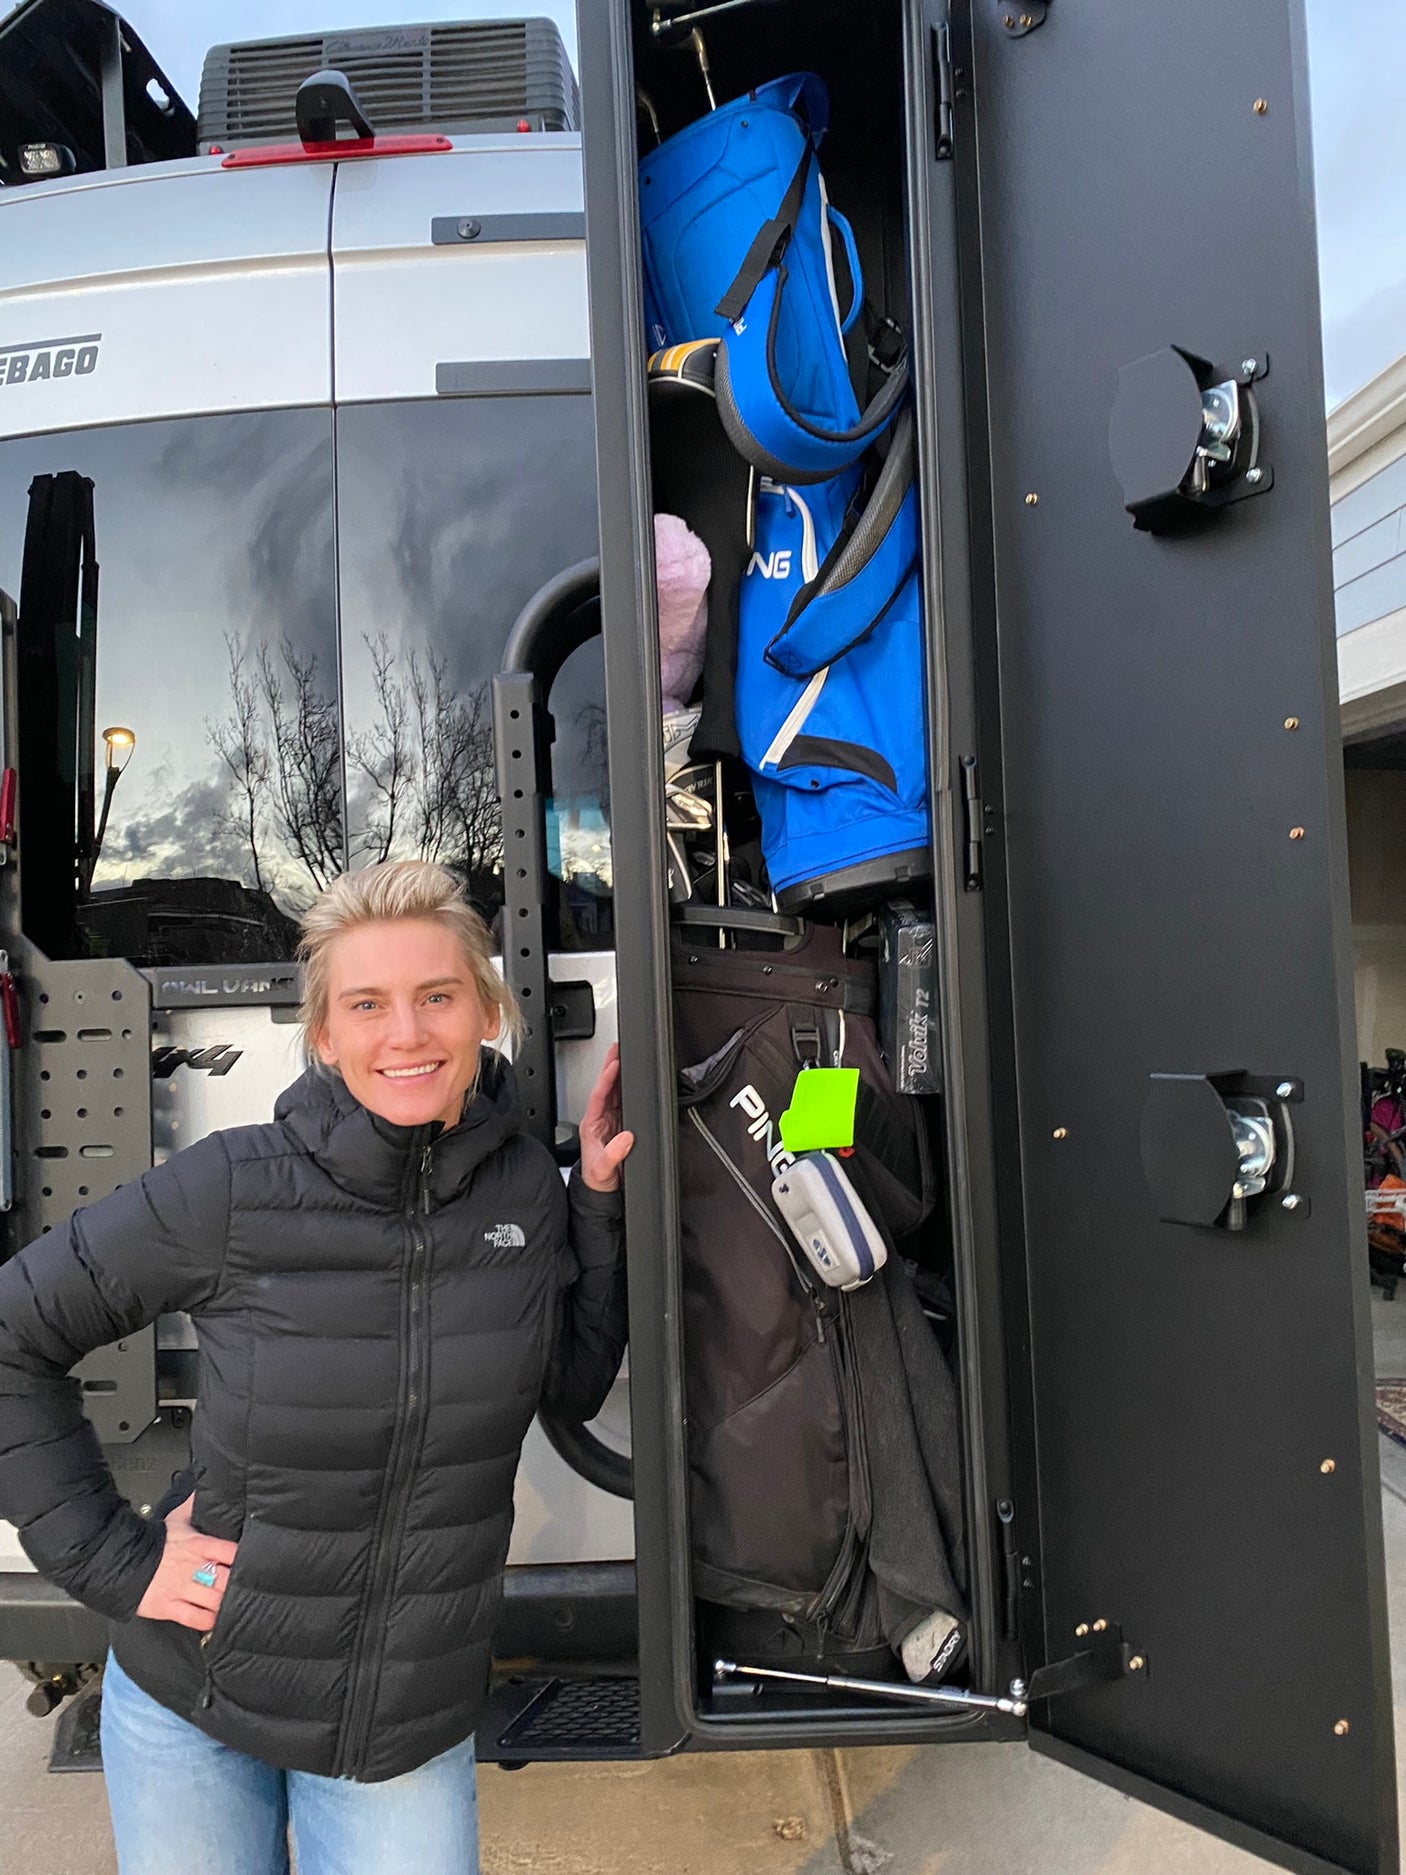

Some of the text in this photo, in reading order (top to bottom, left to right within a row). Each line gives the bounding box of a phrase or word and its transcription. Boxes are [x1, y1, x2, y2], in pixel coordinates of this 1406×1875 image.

[162, 980, 218, 995] OWL
[916, 988, 930, 1008] T2
[729, 1084, 796, 1179] PING
